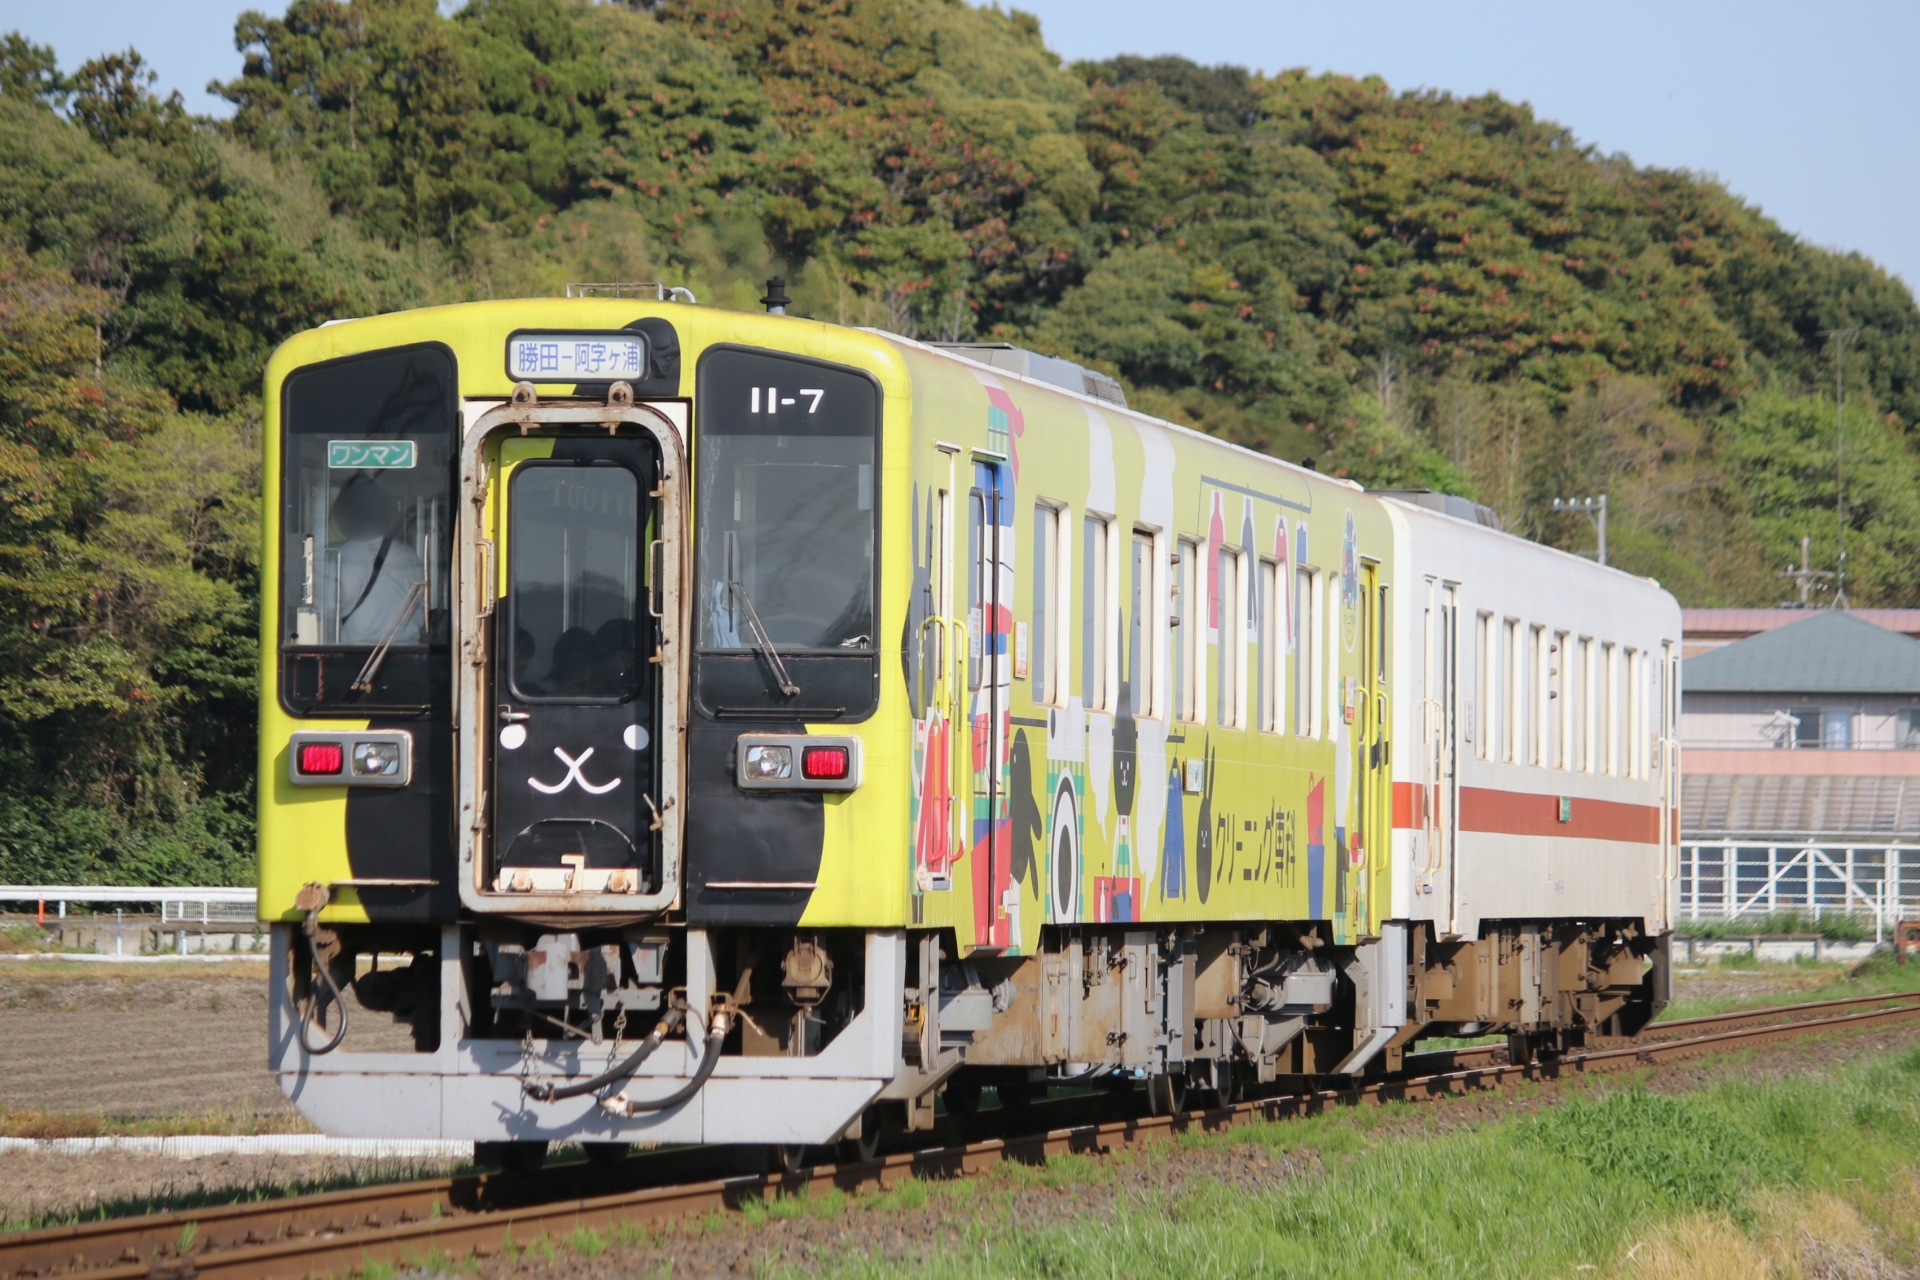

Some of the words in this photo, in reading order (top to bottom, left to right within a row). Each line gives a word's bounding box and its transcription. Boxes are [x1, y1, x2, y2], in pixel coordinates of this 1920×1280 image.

[751, 387, 824, 413] 11-7
[332, 446, 410, 465] ワンマン
[1215, 795, 1295, 888] クリーニング専科
